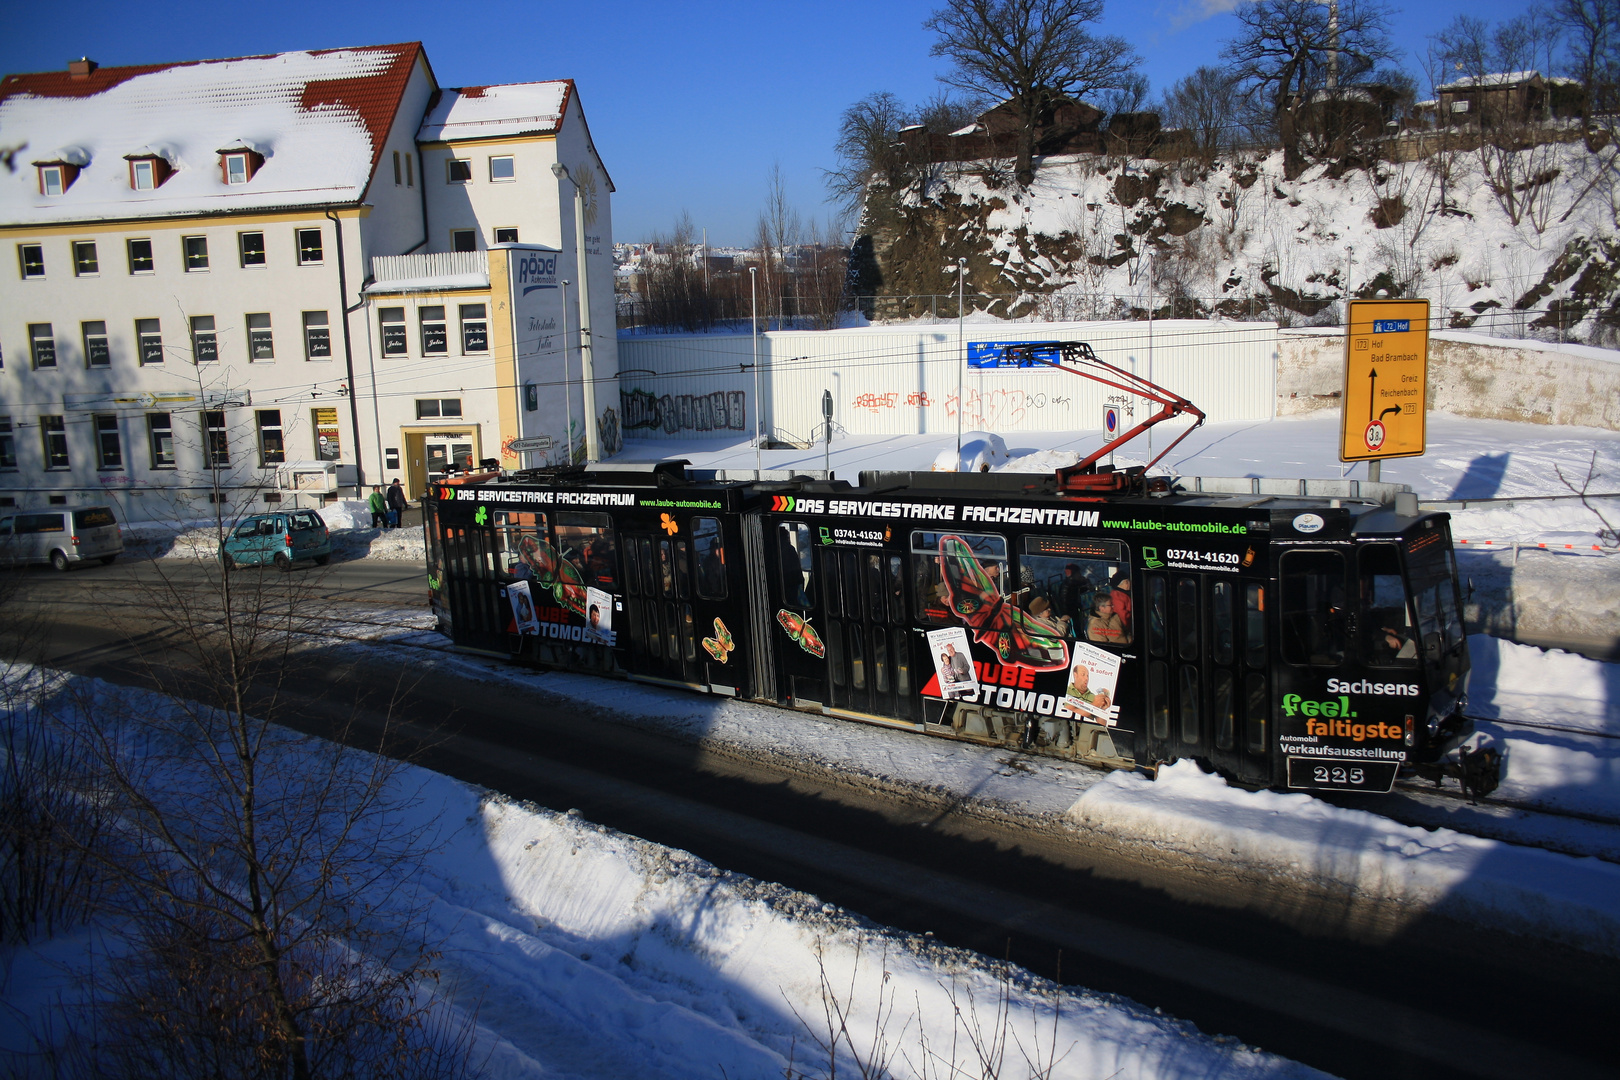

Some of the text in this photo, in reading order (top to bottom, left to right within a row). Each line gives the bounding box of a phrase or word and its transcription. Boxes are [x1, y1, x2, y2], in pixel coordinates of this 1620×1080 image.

[1397, 322, 1408, 330] Hof
[1356, 340, 1383, 348] 173 Hof
[1371, 353, 1418, 362] Bad Brambach
[1381, 388, 1418, 397] Reichenbach
[457, 490, 635, 506] DAS SERVICESTARKE FACHZENTRUM
[640, 499, 722, 508] www.laube-automobile.de
[796, 498, 1100, 528] DAS SERVICESTARKE FACHZENTRUM
[834, 528, 883, 540] 03741-41620
[1102, 519, 1247, 534] www.laube-automobile.de
[1166, 548, 1240, 564] 03741-41620
[1167, 560, 1240, 572] info@laube-automobile.de
[534, 606, 569, 624] AUBE
[973, 660, 1036, 690] AUBE
[1096, 668, 1114, 676] sofort
[1326, 678, 1419, 696] Sachsens
[1281, 694, 1357, 718] feel.
[1306, 718, 1402, 742] faltigste
[1280, 735, 1318, 743] Automobil
[1280, 743, 1406, 760] Verkaufsausstellung
[1314, 766, 1364, 784] 225
